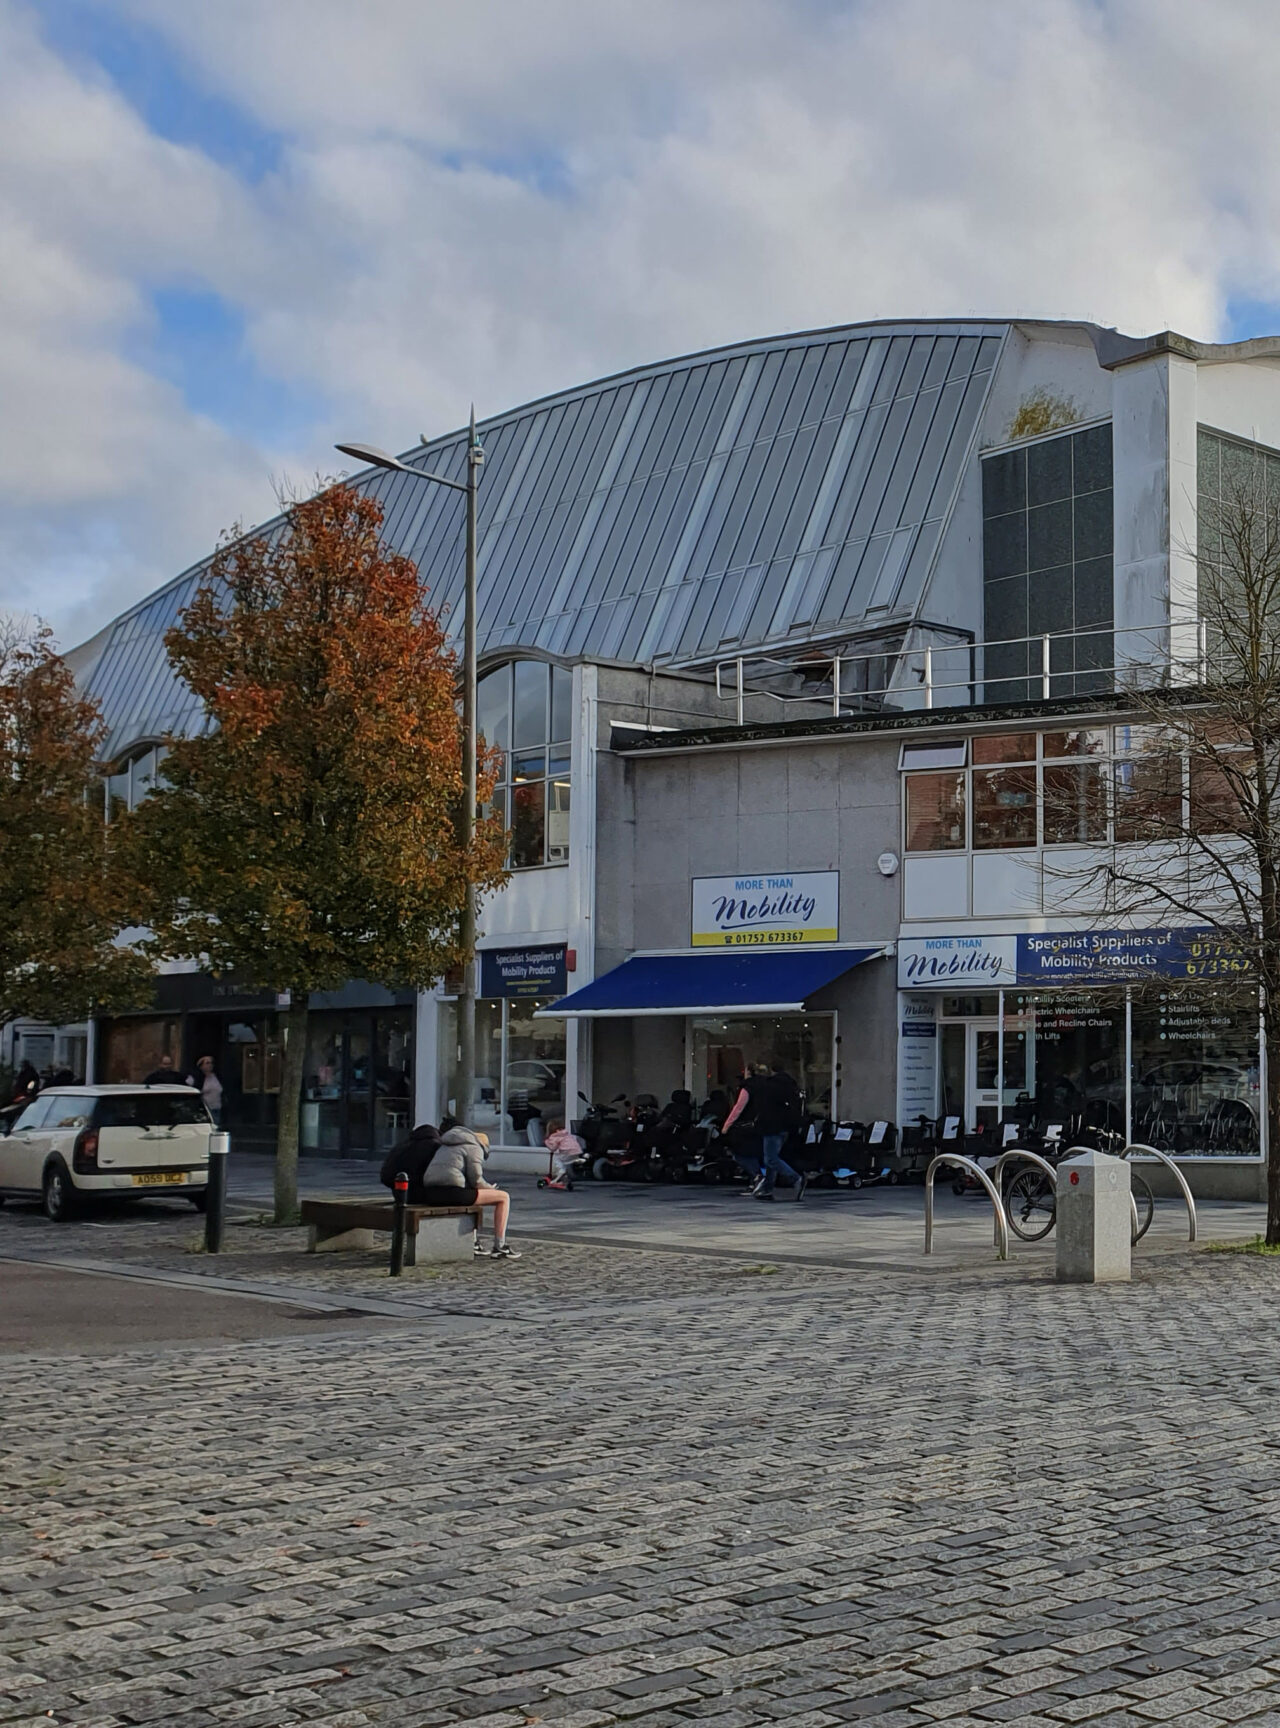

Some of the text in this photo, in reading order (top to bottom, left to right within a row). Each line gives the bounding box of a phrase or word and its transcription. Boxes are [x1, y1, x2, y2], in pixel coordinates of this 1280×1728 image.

[735, 878, 793, 891] MORE THAN
[712, 892, 816, 922] Mobility
[736, 932, 804, 943] 01752 673367
[1027, 936, 1088, 952] Specialist
[1092, 933, 1153, 950] Suppliers
[926, 939, 982, 950] MORE THAN
[496, 950, 563, 966] Specialist Suppliers of
[903, 950, 1003, 978] Mobility
[1041, 952, 1158, 969] Mobility Products
[502, 965, 556, 978] Mobility Products
[1055, 1006, 1100, 1014] Wheelchairs
[1044, 1020, 1057, 1028] and
[1088, 1019, 1112, 1027] Chairs
[1044, 1032, 1061, 1040] Lifts
